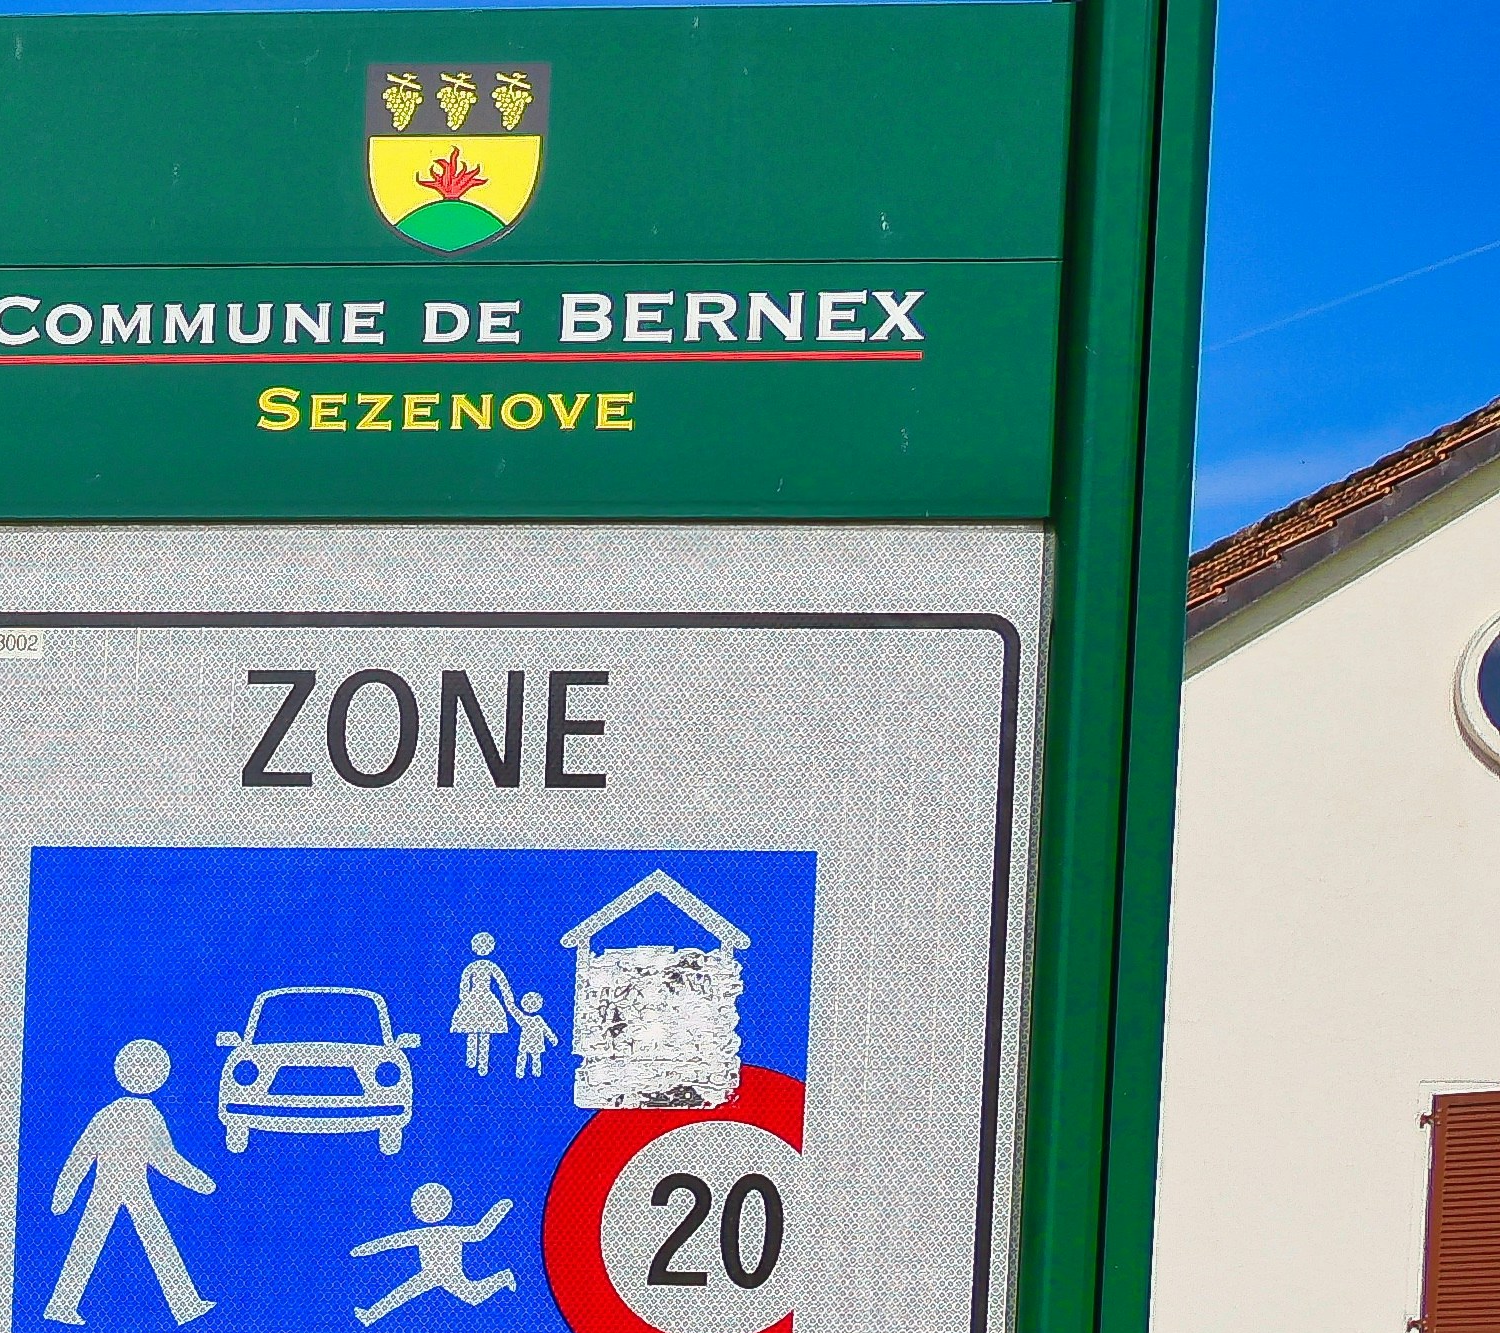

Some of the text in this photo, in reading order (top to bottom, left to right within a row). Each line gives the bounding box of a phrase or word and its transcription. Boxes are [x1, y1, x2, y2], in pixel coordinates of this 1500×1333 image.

[558, 289, 926, 344] BERNEX
[255, 387, 635, 432] SEZENOVE
[241, 669, 610, 789] ZONE
[645, 1172, 786, 1290] 20
